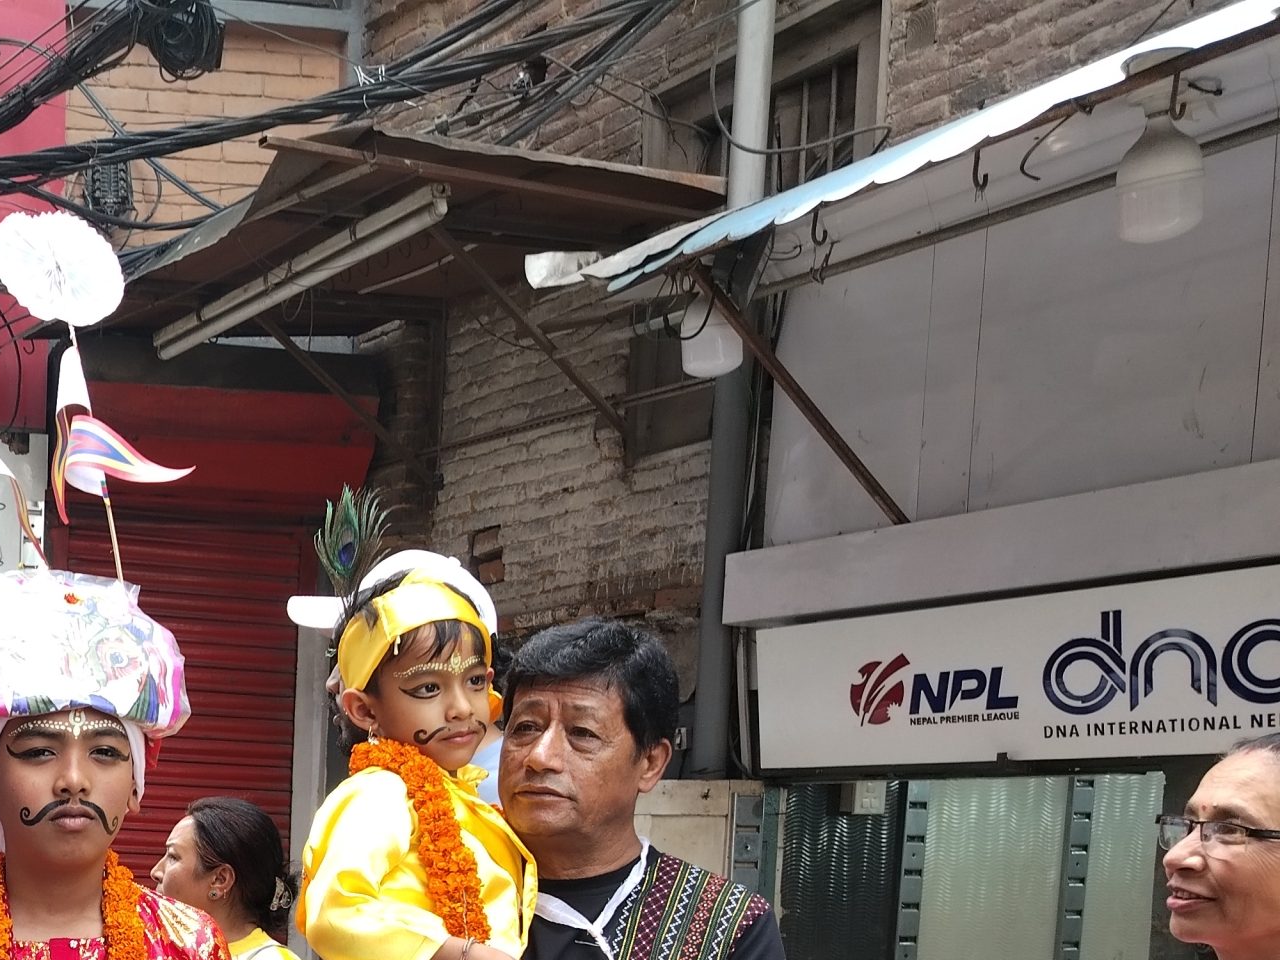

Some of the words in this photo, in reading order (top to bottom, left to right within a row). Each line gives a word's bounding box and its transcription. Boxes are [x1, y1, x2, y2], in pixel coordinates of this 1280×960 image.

[909, 666, 1019, 715] NPL
[910, 715, 938, 726] NEPAL
[940, 713, 979, 724] PREMIER
[981, 711, 1020, 722] LEAGUE
[1044, 724, 1080, 738] DNA
[1087, 715, 1241, 737] INTERNATIONAL
[1250, 712, 1280, 729] NE
